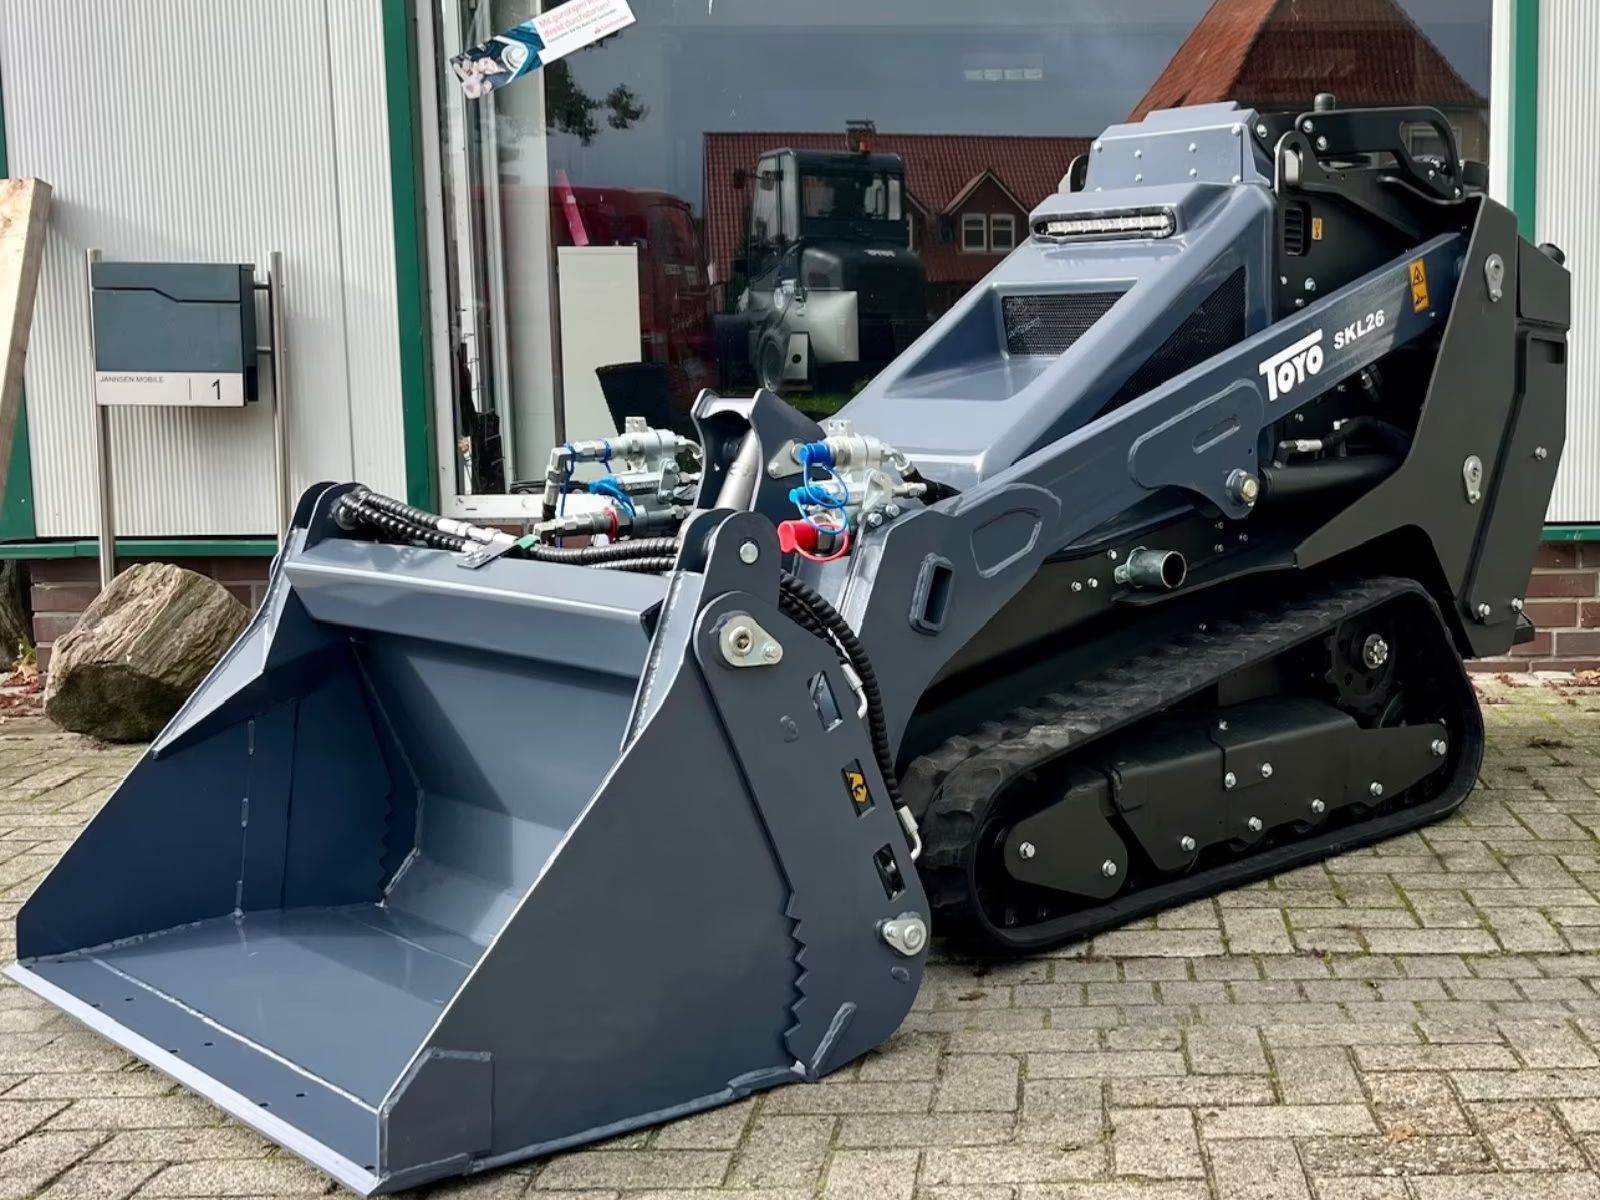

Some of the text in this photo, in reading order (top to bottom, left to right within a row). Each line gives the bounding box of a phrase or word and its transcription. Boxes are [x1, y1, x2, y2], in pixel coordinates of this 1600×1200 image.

[1259, 310, 1385, 402] TOYO SKL26
[212, 379, 221, 400] 1
